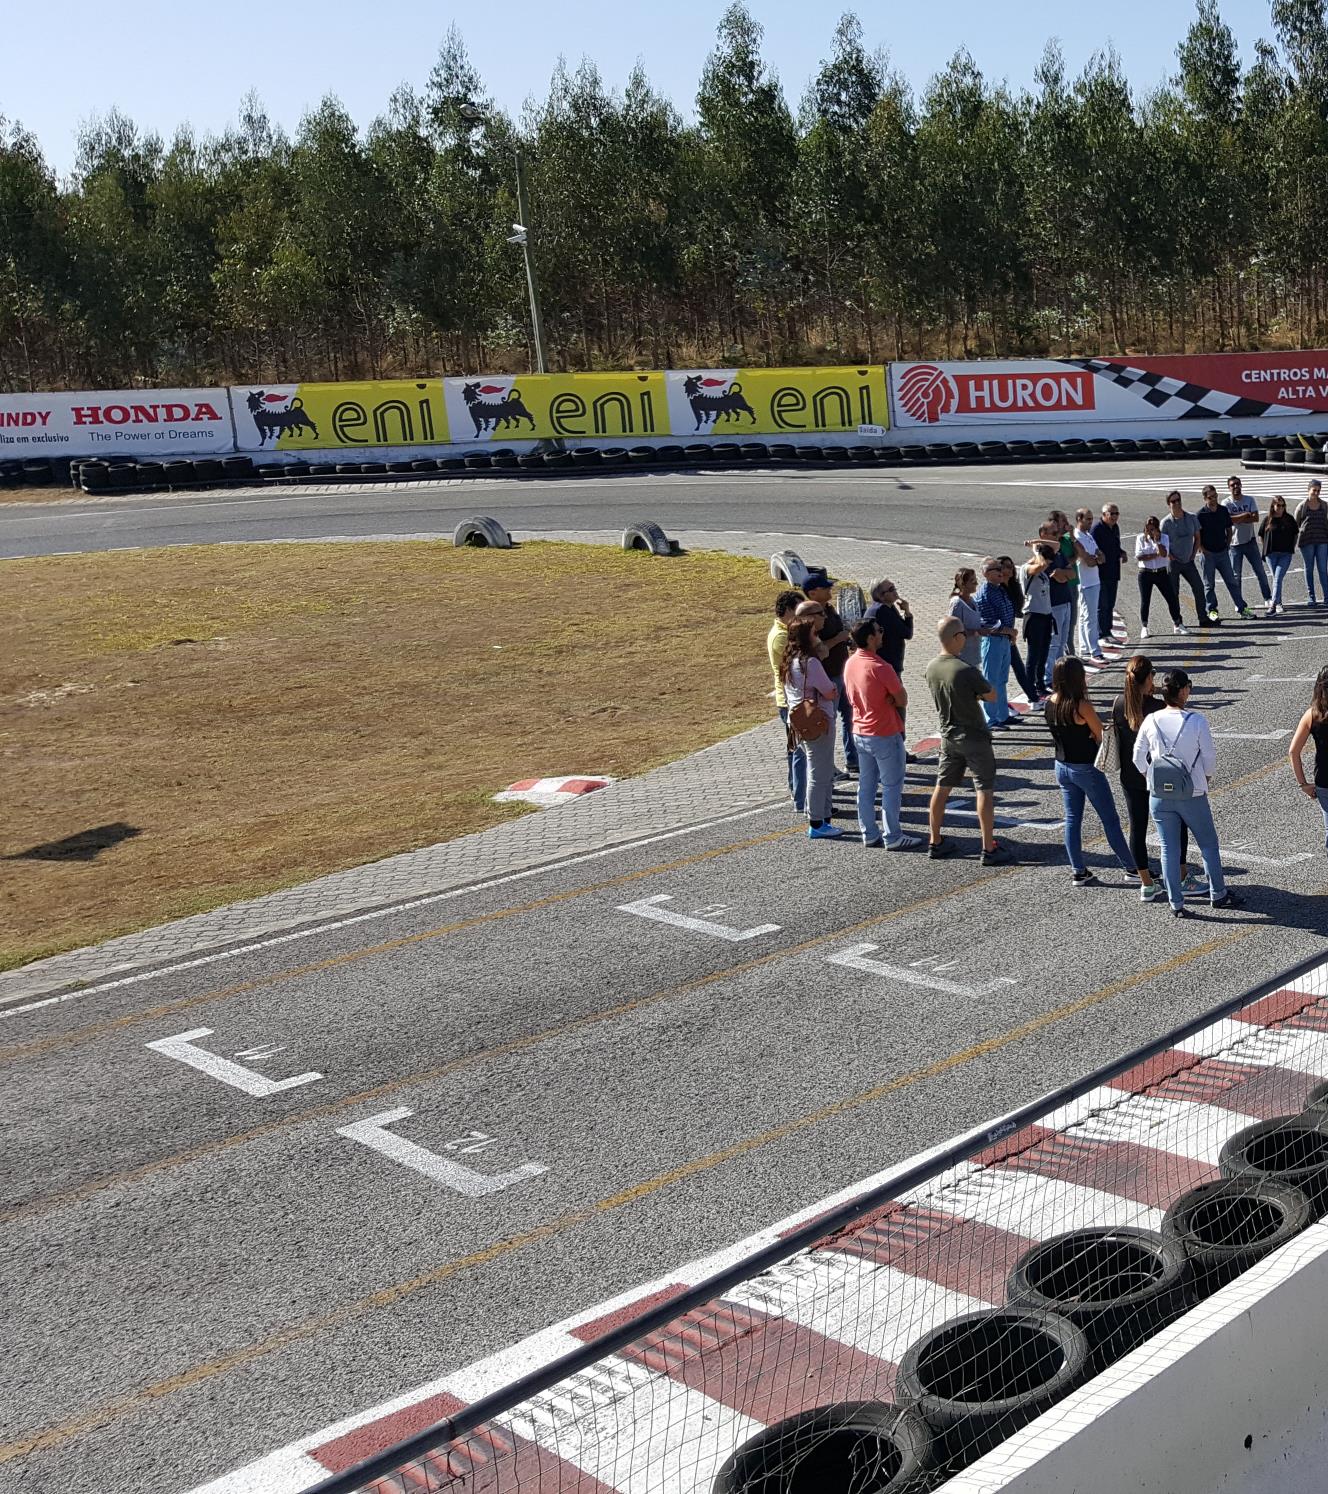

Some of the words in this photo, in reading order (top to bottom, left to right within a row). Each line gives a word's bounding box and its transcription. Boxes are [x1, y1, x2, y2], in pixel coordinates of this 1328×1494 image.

[1241, 366, 1309, 384] CENTROS
[770, 369, 876, 429] eni
[968, 376, 1085, 408] HURON
[1278, 383, 1318, 400] ALTA
[71, 403, 223, 426] HONDA
[332, 384, 436, 444] eni
[549, 375, 656, 435] eni
[0, 411, 51, 427] INDY
[16, 435, 29, 444] em
[31, 432, 70, 443] exclusivo
[88, 431, 112, 442] The
[115, 430, 151, 441] Power
[168, 429, 215, 440] Dreams
